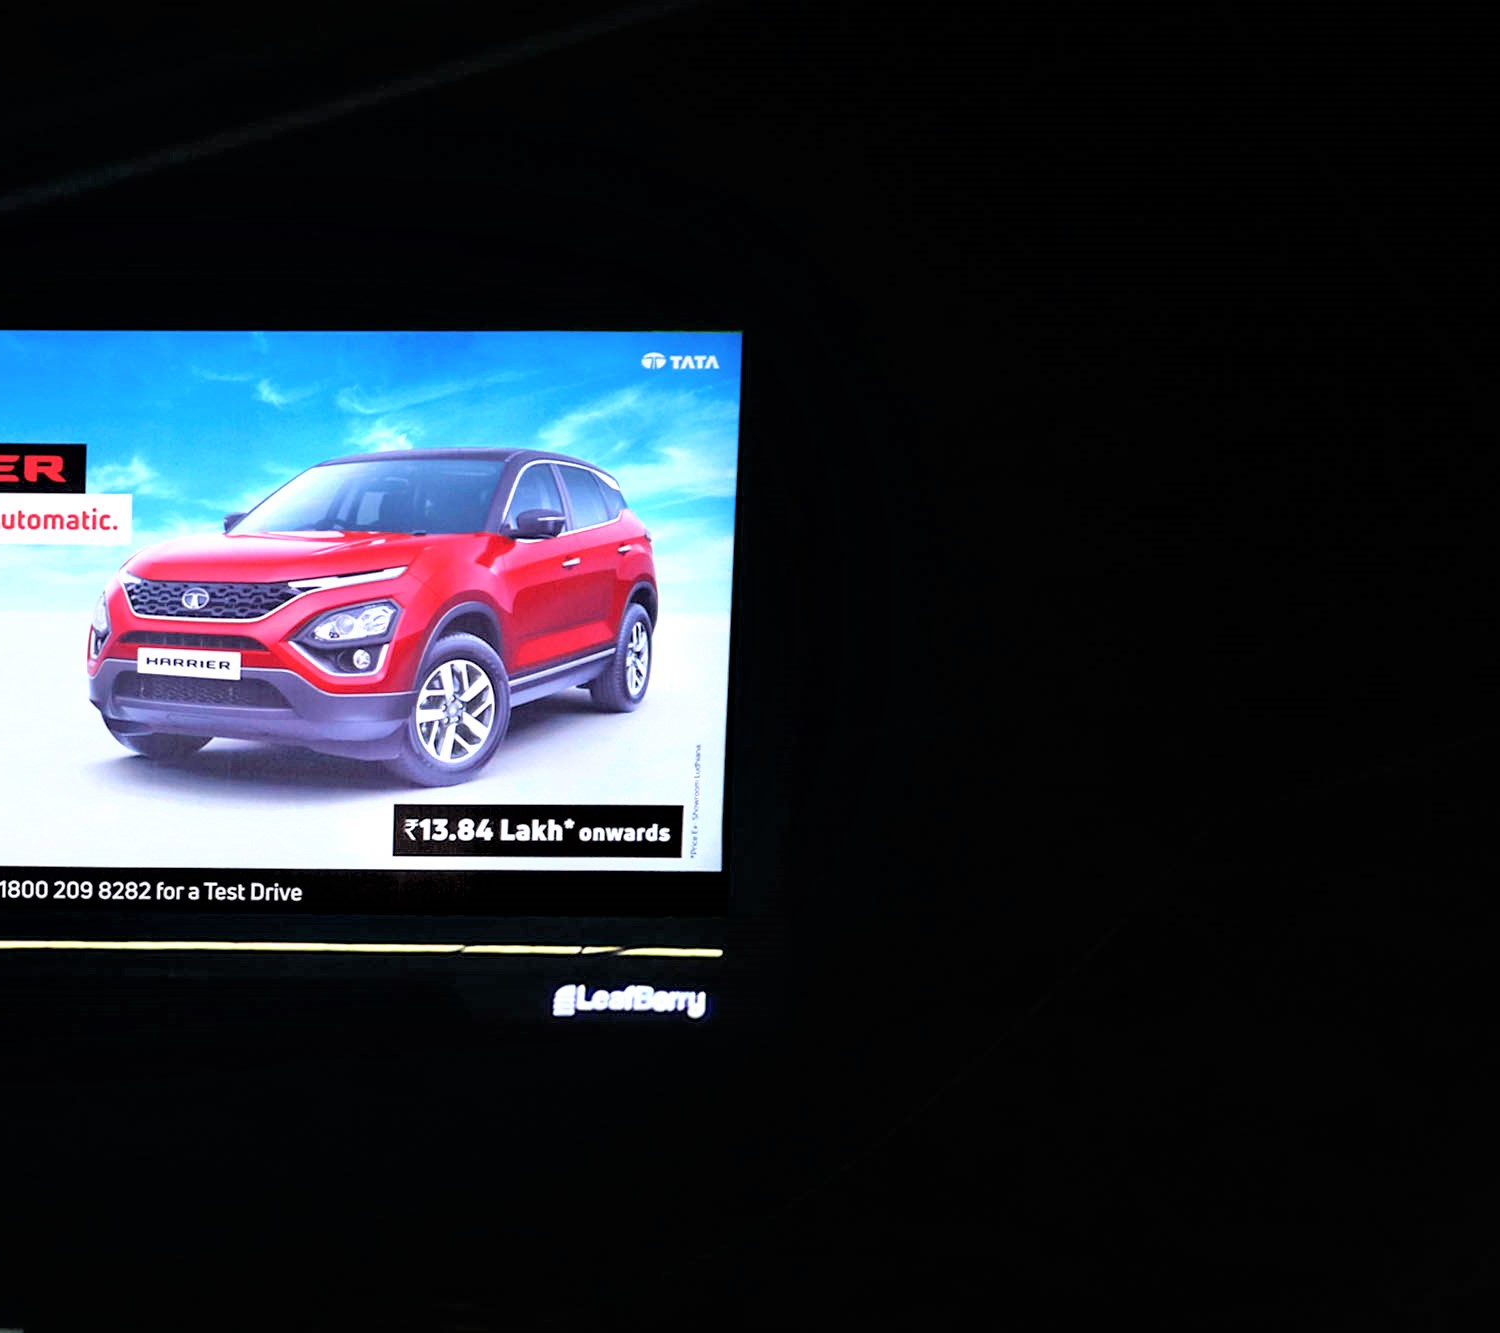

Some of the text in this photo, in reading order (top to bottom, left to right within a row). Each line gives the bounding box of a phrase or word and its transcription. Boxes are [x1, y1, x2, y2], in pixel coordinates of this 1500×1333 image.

[669, 355, 719, 370] TATA
[146, 657, 231, 670] HARRIER
[404, 818, 494, 842] ₹13.84
[578, 824, 671, 842] onwards
[53, 880, 93, 900] 209
[98, 881, 152, 900] 8282
[156, 882, 186, 900] for
[188, 886, 200, 900] a
[203, 882, 246, 901] Test
[250, 882, 303, 901] Drive
